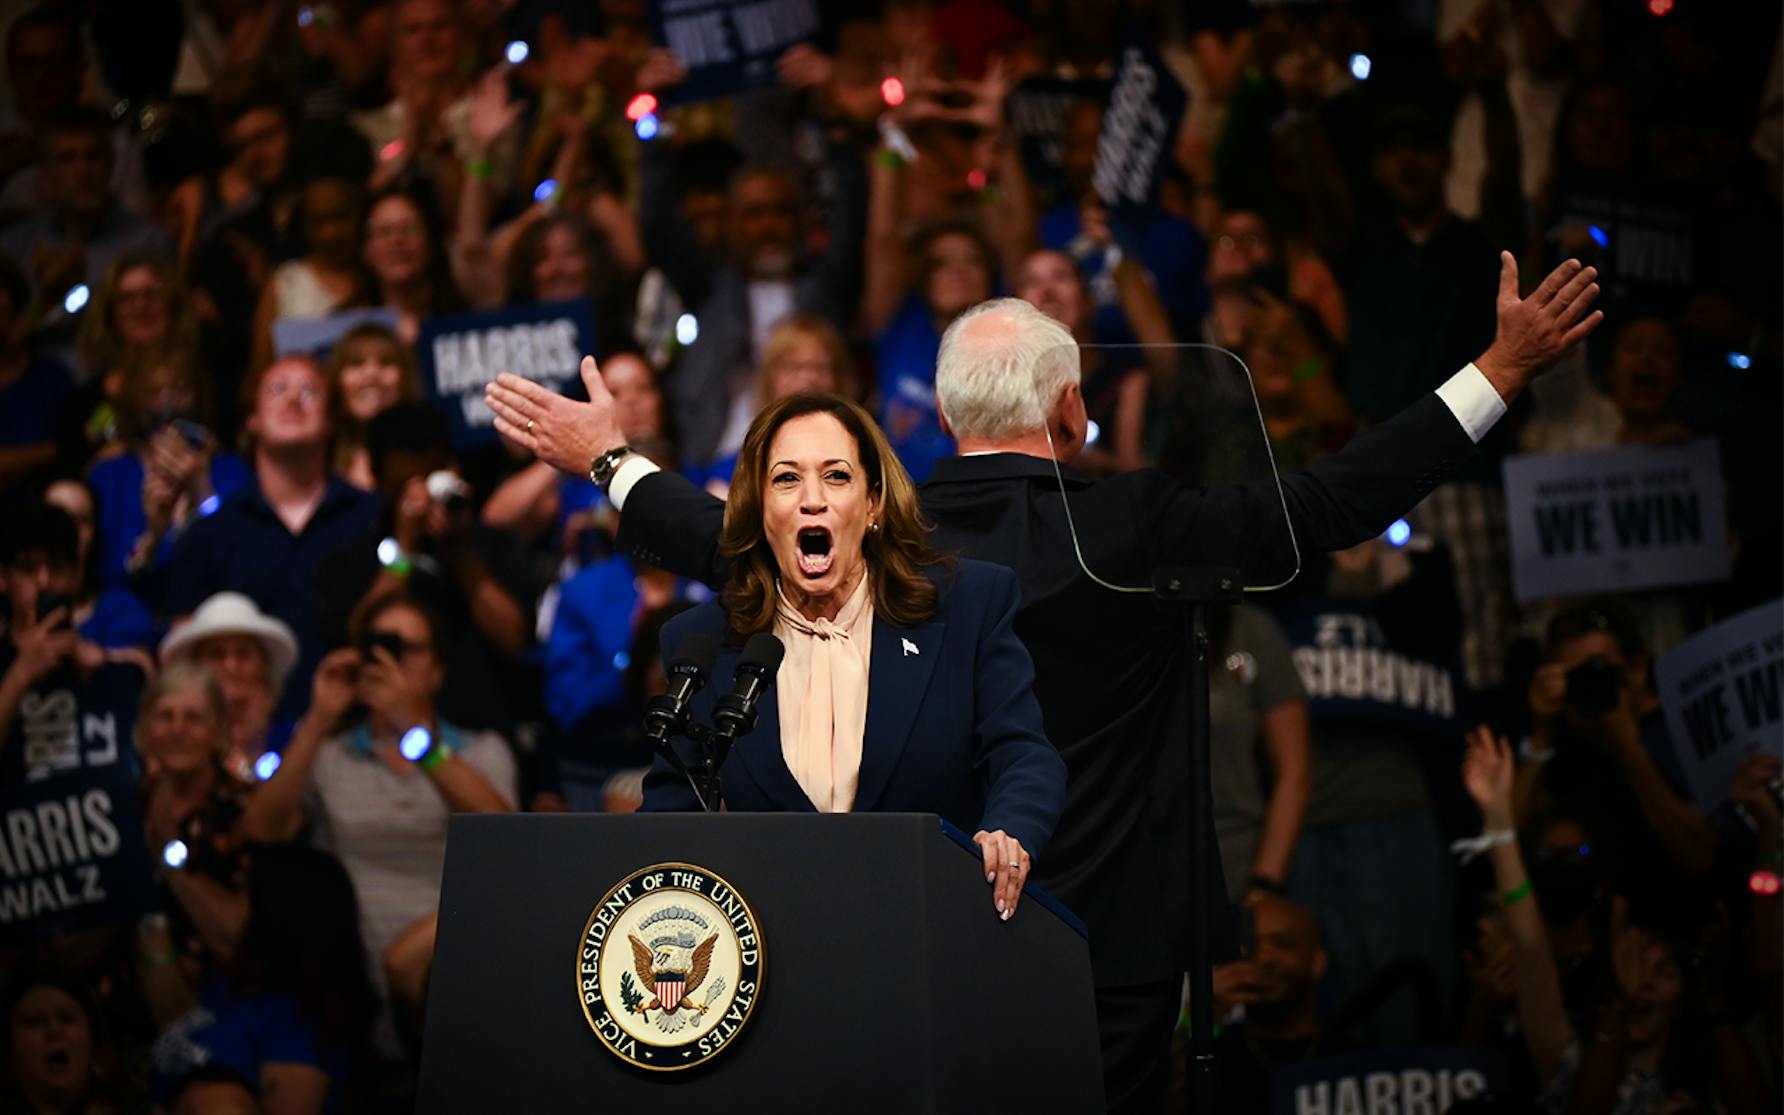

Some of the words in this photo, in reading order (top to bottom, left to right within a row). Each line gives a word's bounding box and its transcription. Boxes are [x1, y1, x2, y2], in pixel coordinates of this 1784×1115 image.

[433, 317, 578, 397] HARRIS
[1534, 501, 1599, 557] WE
[1611, 489, 1702, 548] WIN
[1292, 645, 1456, 720] HARRIS
[1682, 683, 1735, 760] WE
[641, 872, 665, 891] OF
[670, 871, 704, 891] THE
[580, 883, 635, 1006] PRESIDENT
[709, 881, 758, 967] UNITED
[594, 1010, 638, 1060] VICE
[696, 979, 756, 1057] STATES
